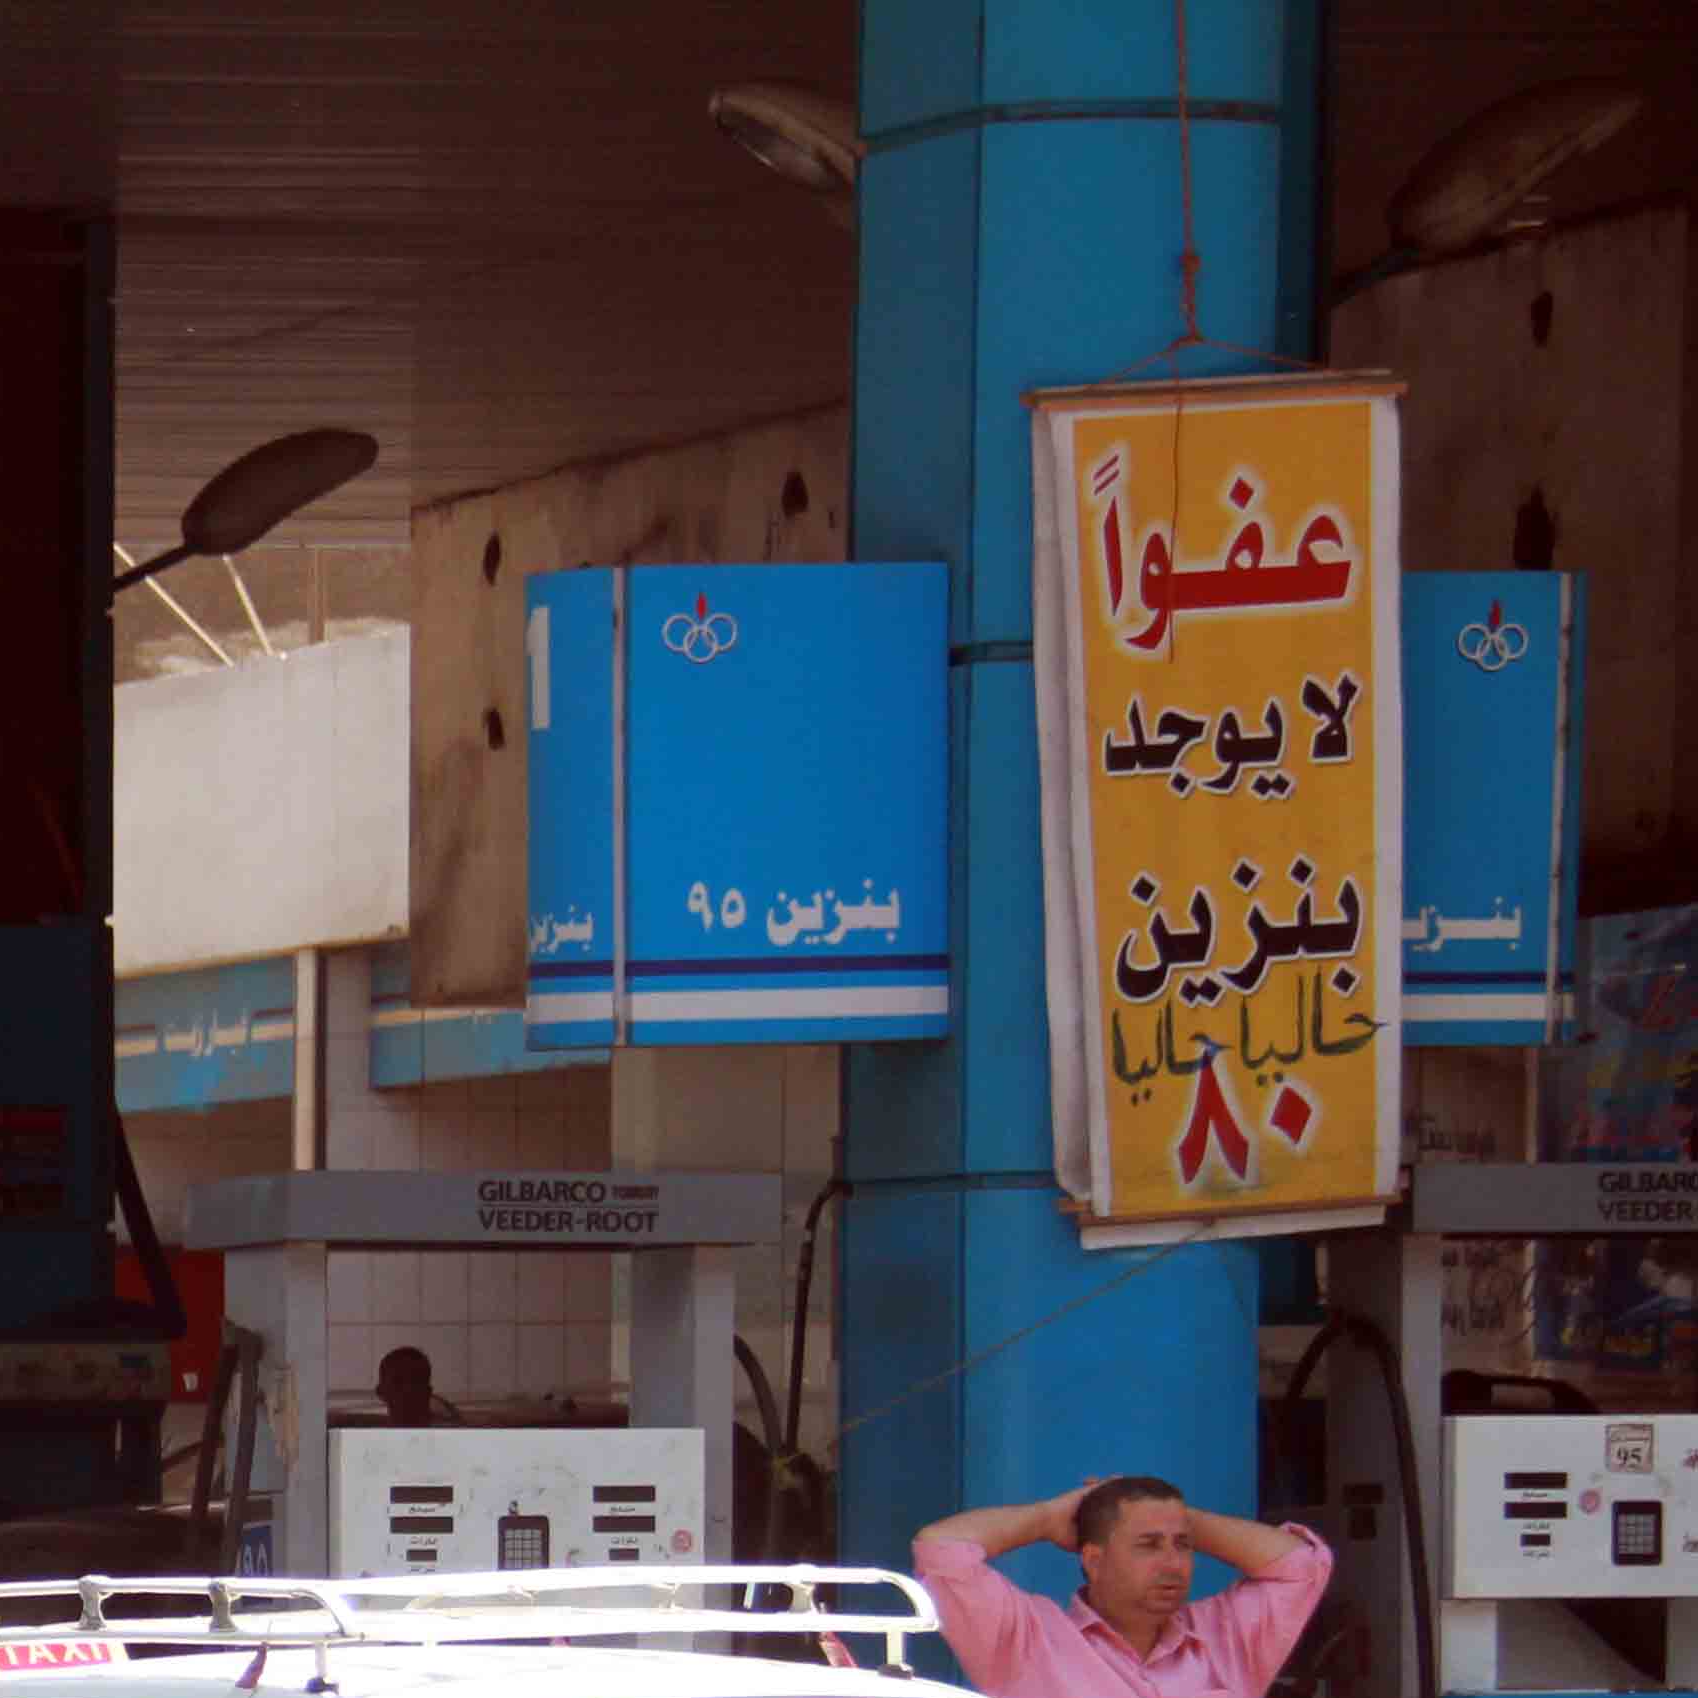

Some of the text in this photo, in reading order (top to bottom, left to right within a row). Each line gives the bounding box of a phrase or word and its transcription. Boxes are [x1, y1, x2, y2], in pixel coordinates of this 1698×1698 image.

[1092, 453, 1352, 651] عفواً
[1105, 673, 1359, 793] لا يوجد
[687, 878, 900, 946] بنزين ٩٥
[1116, 857, 1361, 1000] بنزين
[1178, 1046, 1313, 1185] ٨٠
[478, 1178, 607, 1203] GILBARCO
[478, 1207, 660, 1233] VEEDER-ROOT
[1616, 1447, 1642, 1465] 95
[0, 1641, 114, 1666] TAXI
